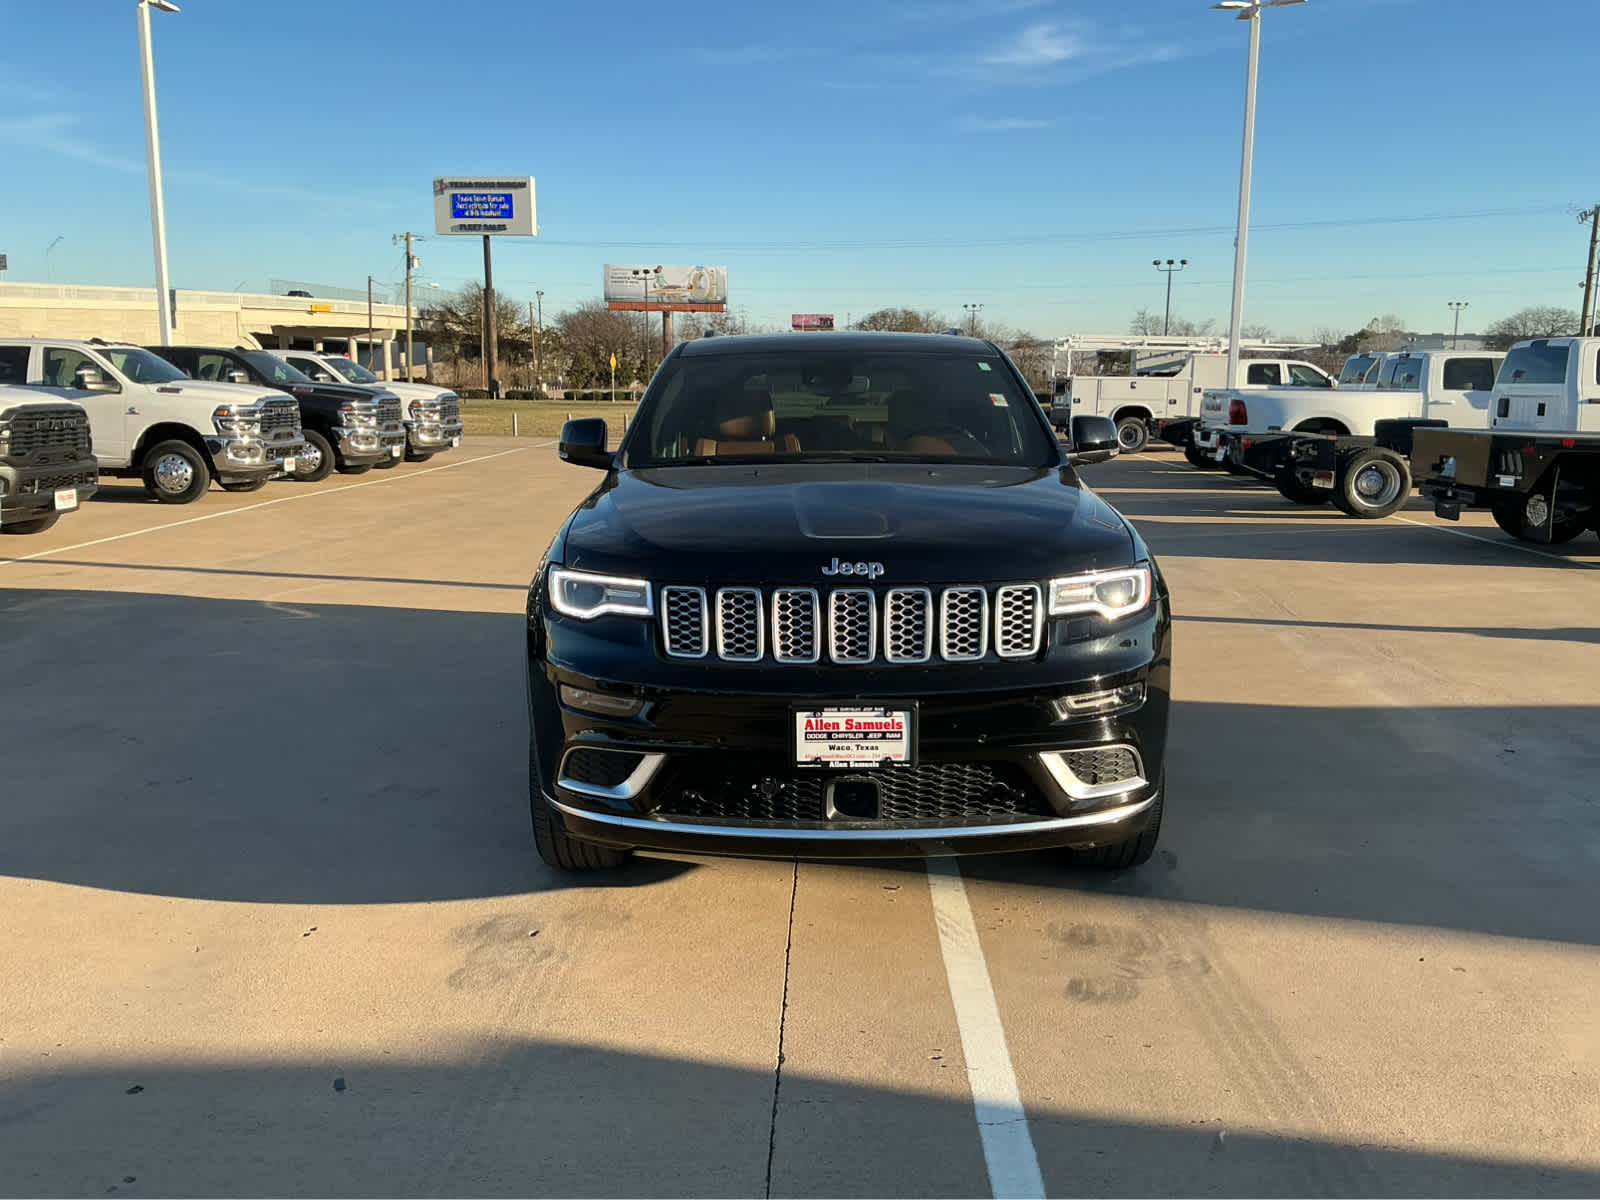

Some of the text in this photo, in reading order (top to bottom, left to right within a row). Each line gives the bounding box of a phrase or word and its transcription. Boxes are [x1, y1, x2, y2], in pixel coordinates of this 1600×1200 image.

[821, 557, 885, 580] Jeep
[805, 718, 903, 731] Allen Samuels
